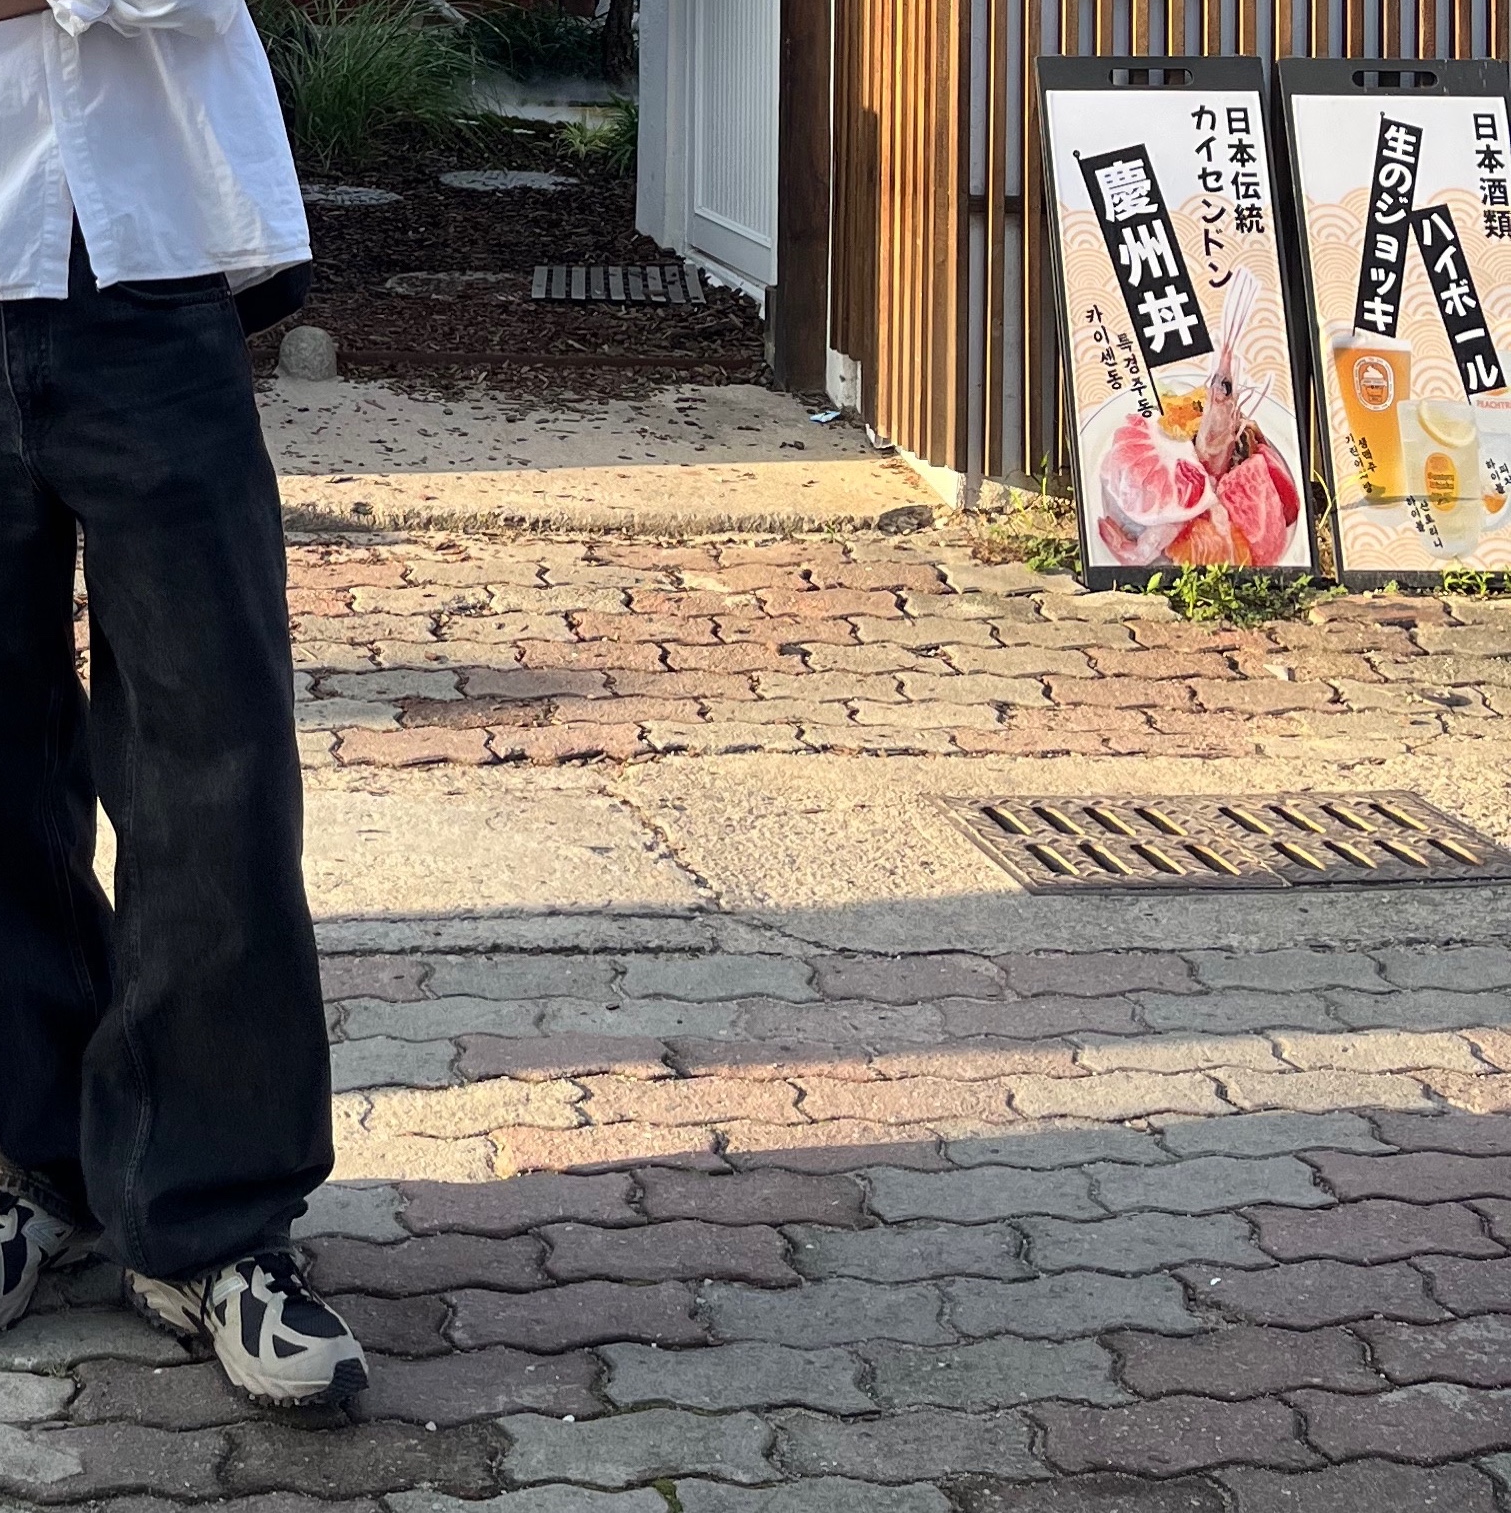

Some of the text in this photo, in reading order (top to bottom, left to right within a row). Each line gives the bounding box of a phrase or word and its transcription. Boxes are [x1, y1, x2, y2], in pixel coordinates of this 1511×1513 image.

[1094, 158, 1200, 355] 慶州丼
[1191, 104, 1234, 289] カイセンドン
[1226, 107, 1265, 234] 日本伝統
[1362, 124, 1418, 333] 生のジョッキ
[1472, 112, 1511, 240] 日本酒類
[1085, 304, 1124, 391] 카이센동
[1421, 211, 1499, 391] ハイボール
